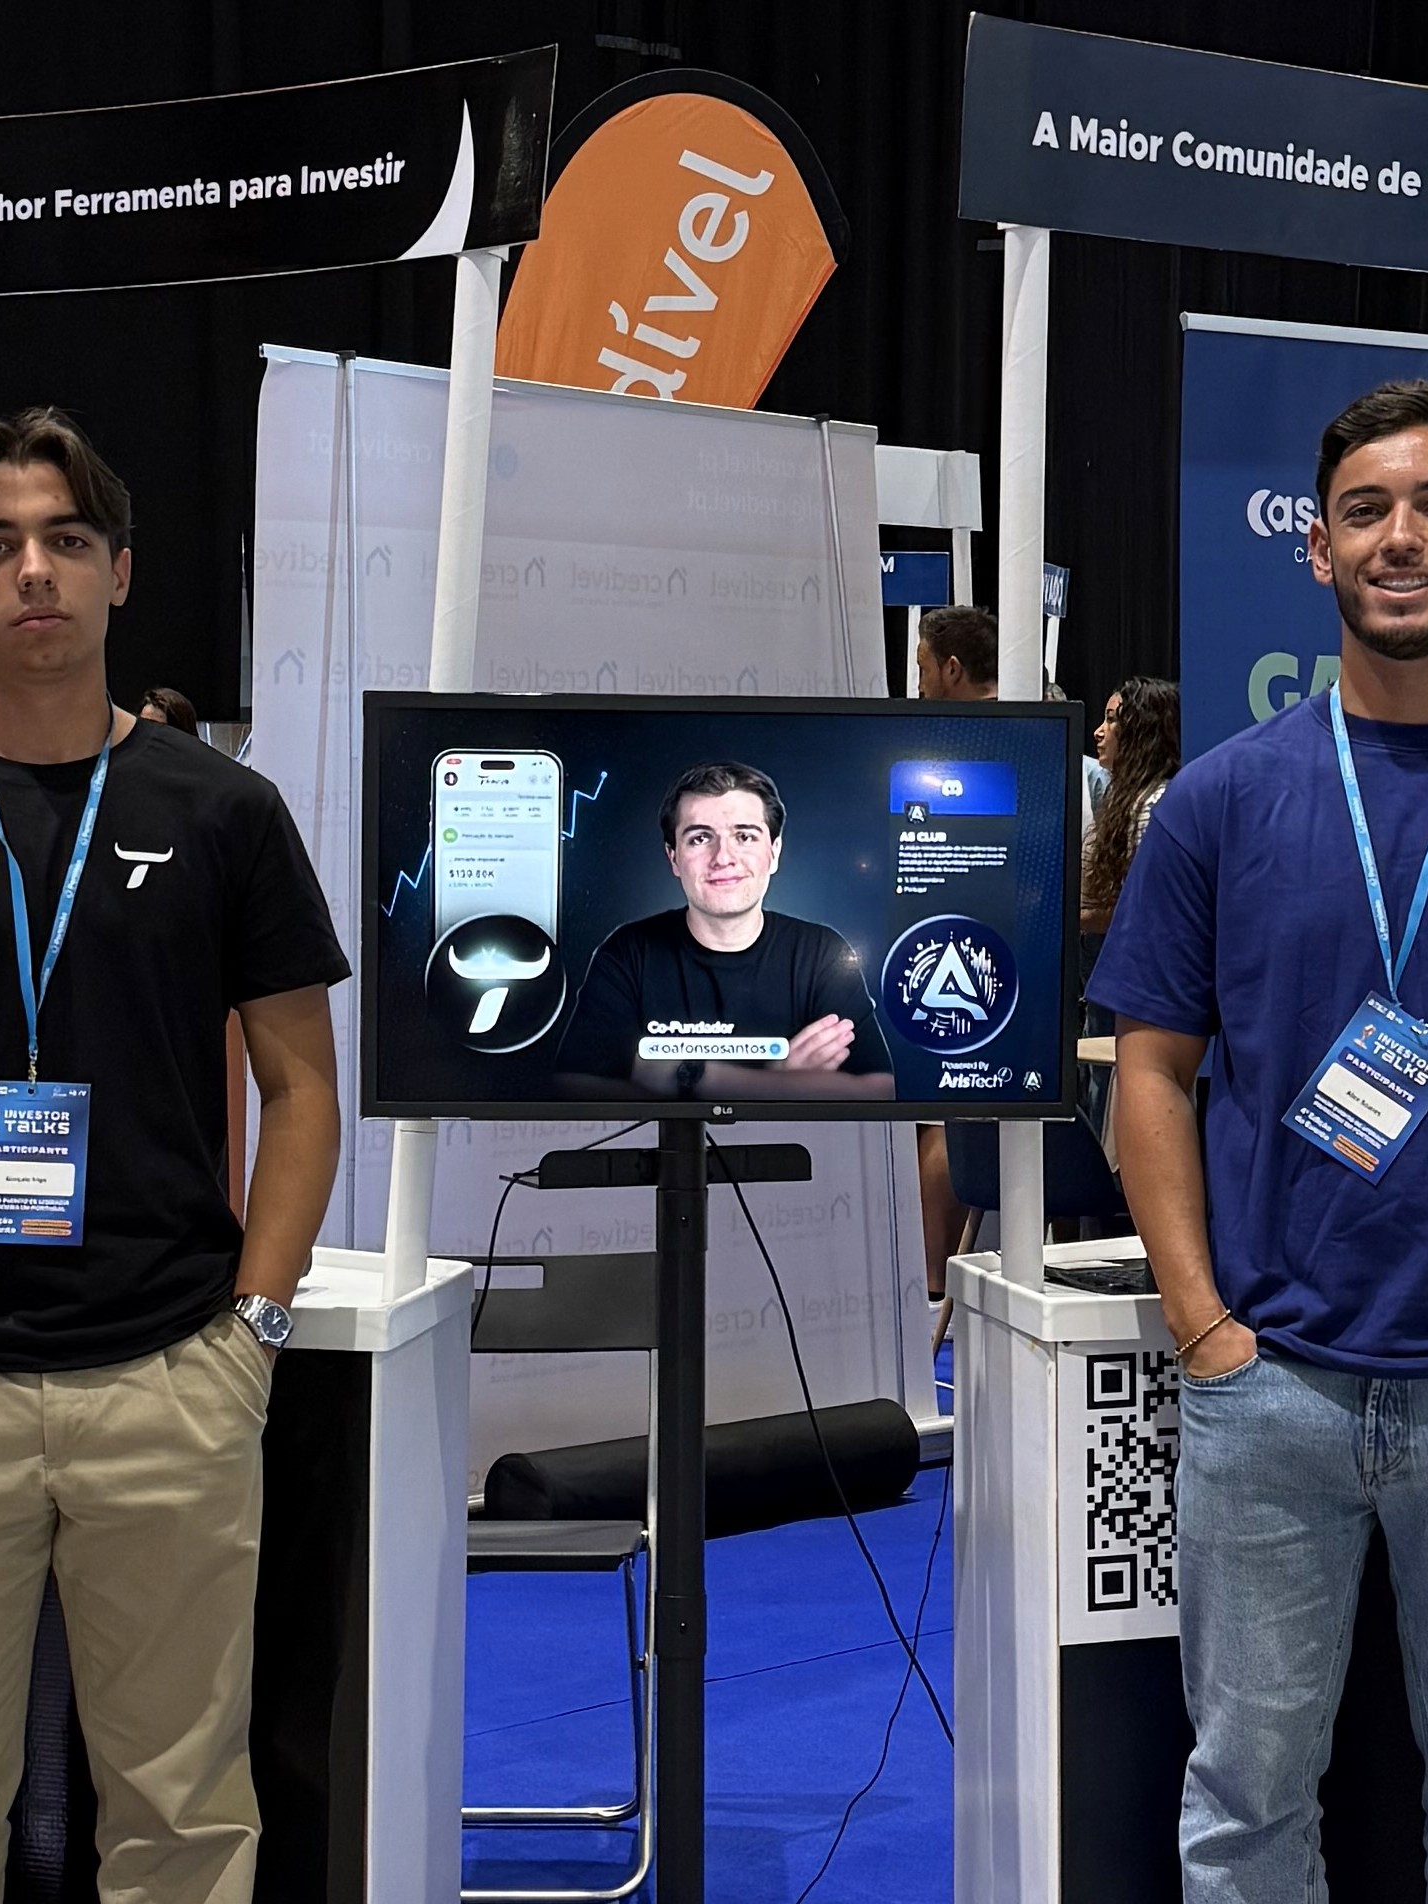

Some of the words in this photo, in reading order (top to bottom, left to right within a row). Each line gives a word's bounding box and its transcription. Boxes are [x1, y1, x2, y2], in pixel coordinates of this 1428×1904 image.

[1032, 111, 1059, 149] A
[1070, 116, 1163, 162] Maior
[1172, 131, 1369, 193] Comunidade
[1377, 160, 1421, 198] de
[54, 176, 222, 217] Ferramenta
[228, 173, 292, 210] para
[300, 151, 405, 195] Investir
[647, 1021, 734, 1034] Co-Fundador
[4, 1109, 70, 1121] INVESTOR
